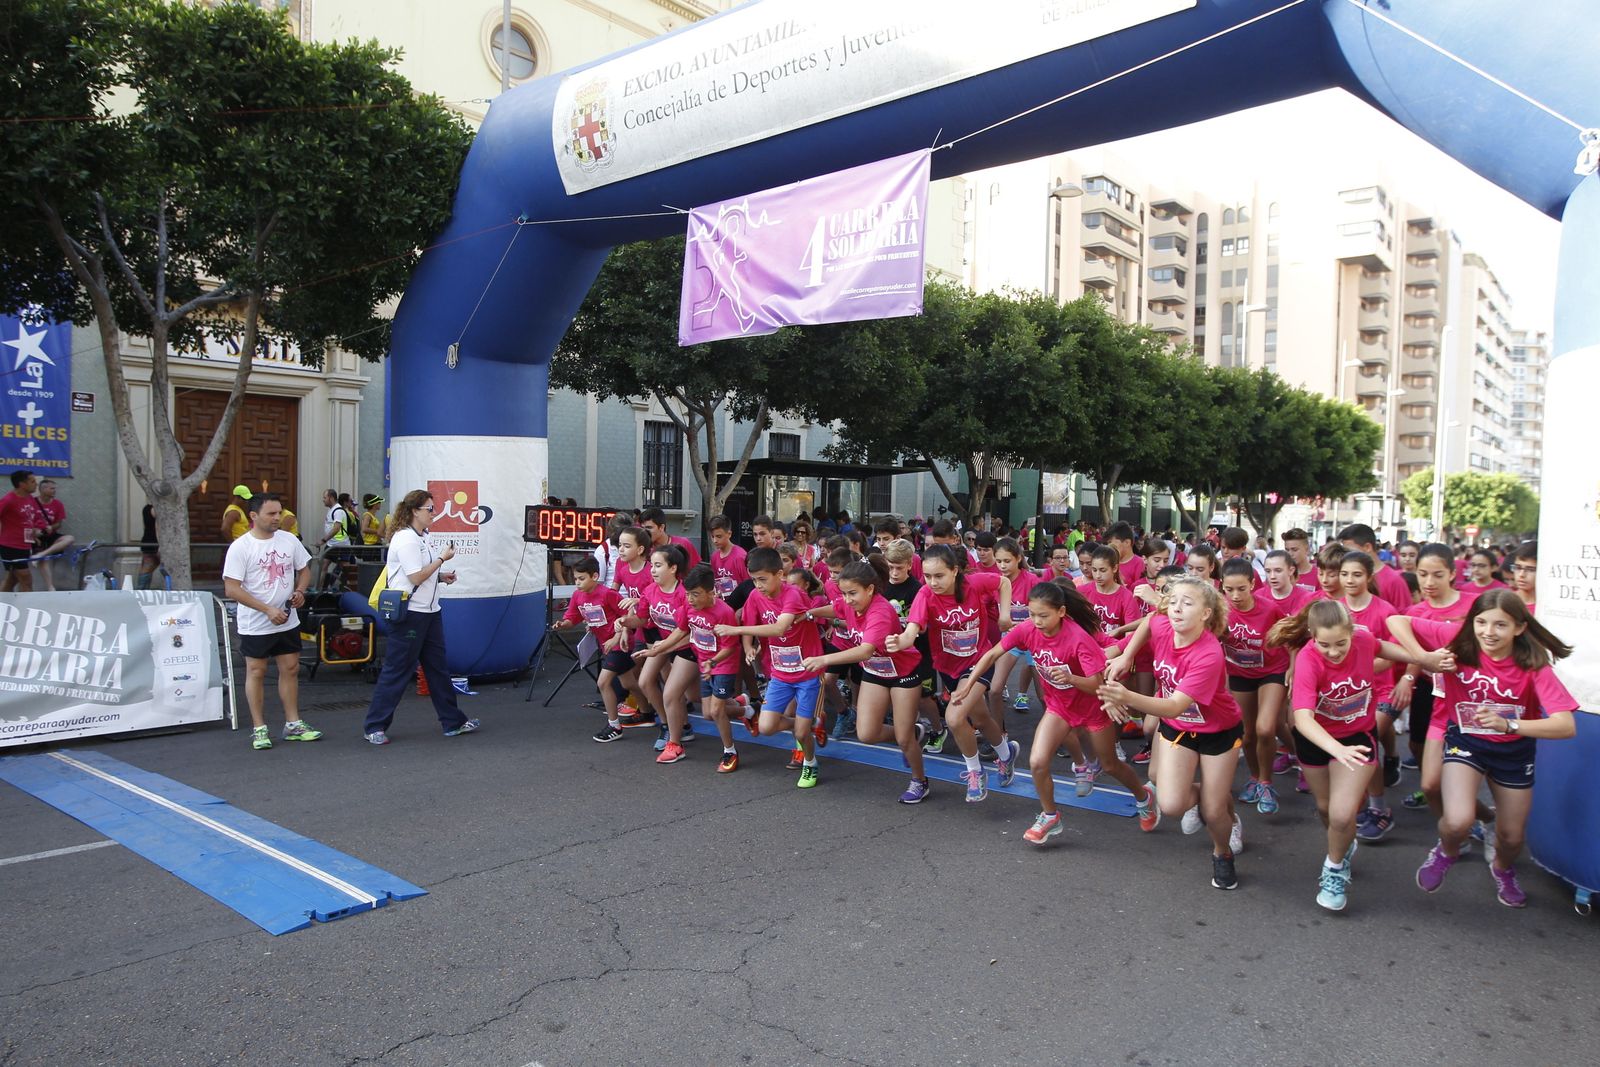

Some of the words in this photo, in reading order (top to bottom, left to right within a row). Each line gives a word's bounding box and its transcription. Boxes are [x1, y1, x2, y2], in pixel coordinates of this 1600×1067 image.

[622, 60, 686, 98] EXCMO.
[688, 19, 808, 76] AYUNTAMIE
[623, 85, 703, 130] Concejalía
[706, 78, 729, 104] de
[732, 50, 818, 98] Deportes
[823, 45, 836, 71] y
[798, 214, 830, 288] 4
[8, 389, 32, 397] desde
[35, 390, 55, 400] 1909
[433, 539, 480, 548] EPORTES
[1560, 585, 1581, 600] DE
[171, 655, 200, 663] FEDER
[42, 685, 65, 697] POCO
